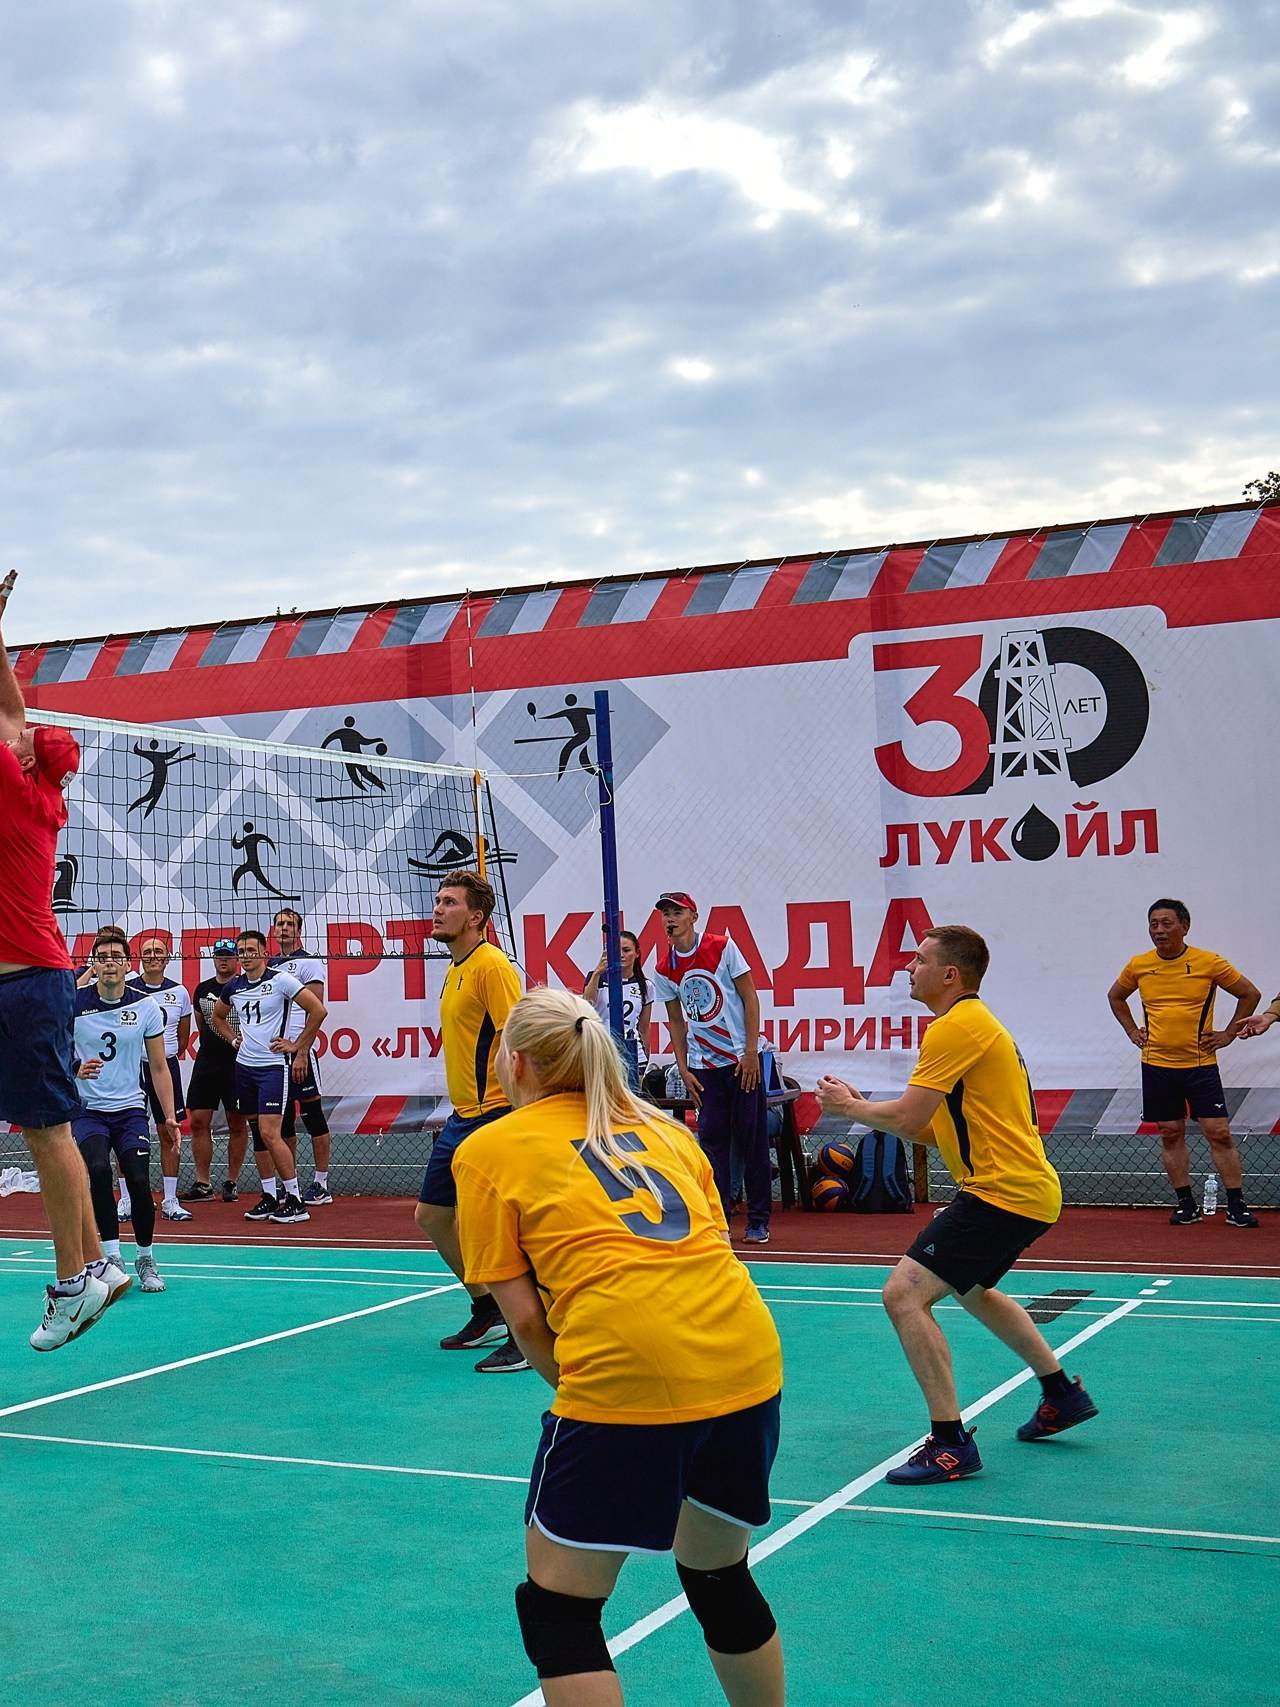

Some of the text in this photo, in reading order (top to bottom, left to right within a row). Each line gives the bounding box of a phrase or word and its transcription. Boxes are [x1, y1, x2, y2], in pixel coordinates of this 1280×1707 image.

[242, 1001, 261, 1024] 11
[99, 1031, 117, 1062] 3
[570, 1131, 691, 1242] 5
